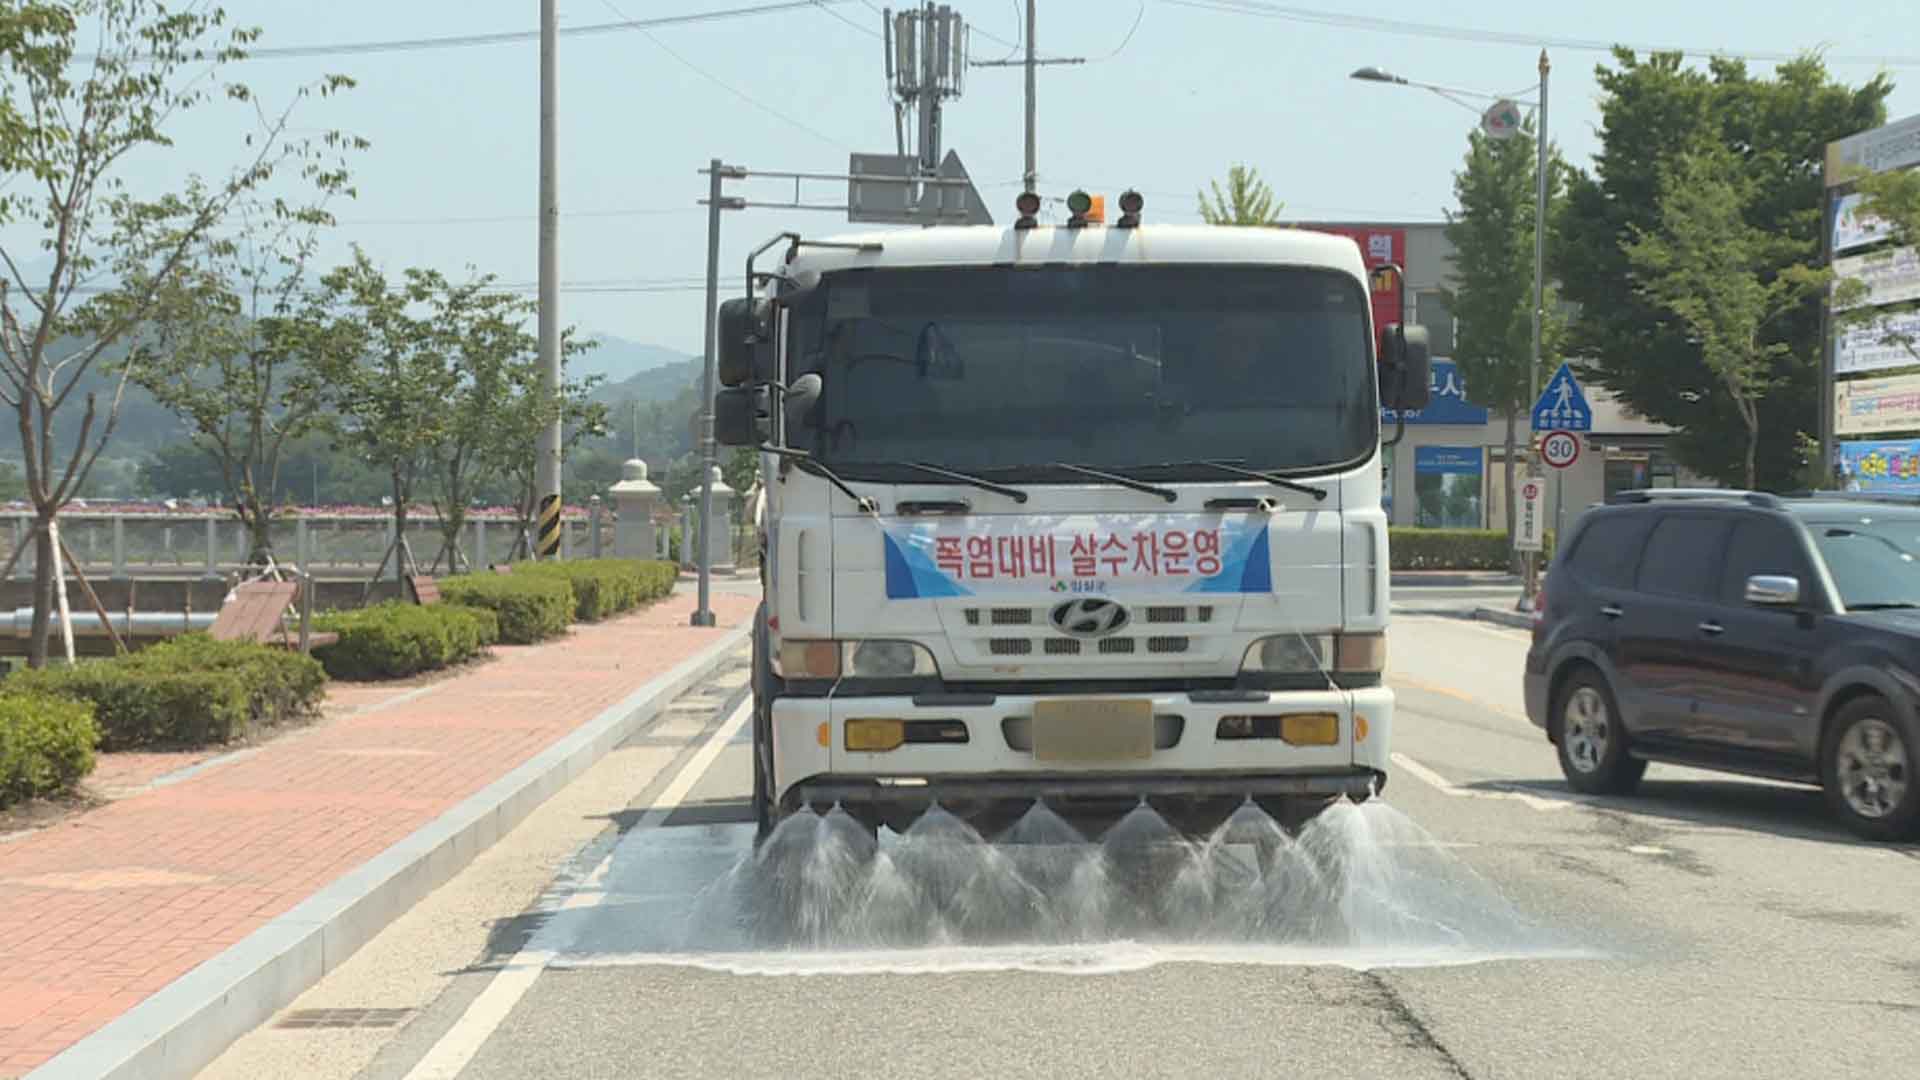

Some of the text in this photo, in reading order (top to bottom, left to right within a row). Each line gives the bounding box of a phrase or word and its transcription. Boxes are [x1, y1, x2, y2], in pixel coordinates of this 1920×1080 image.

[1549, 440, 1572, 457] 30
[935, 529, 1221, 579] 폭염대비 살수차운영
